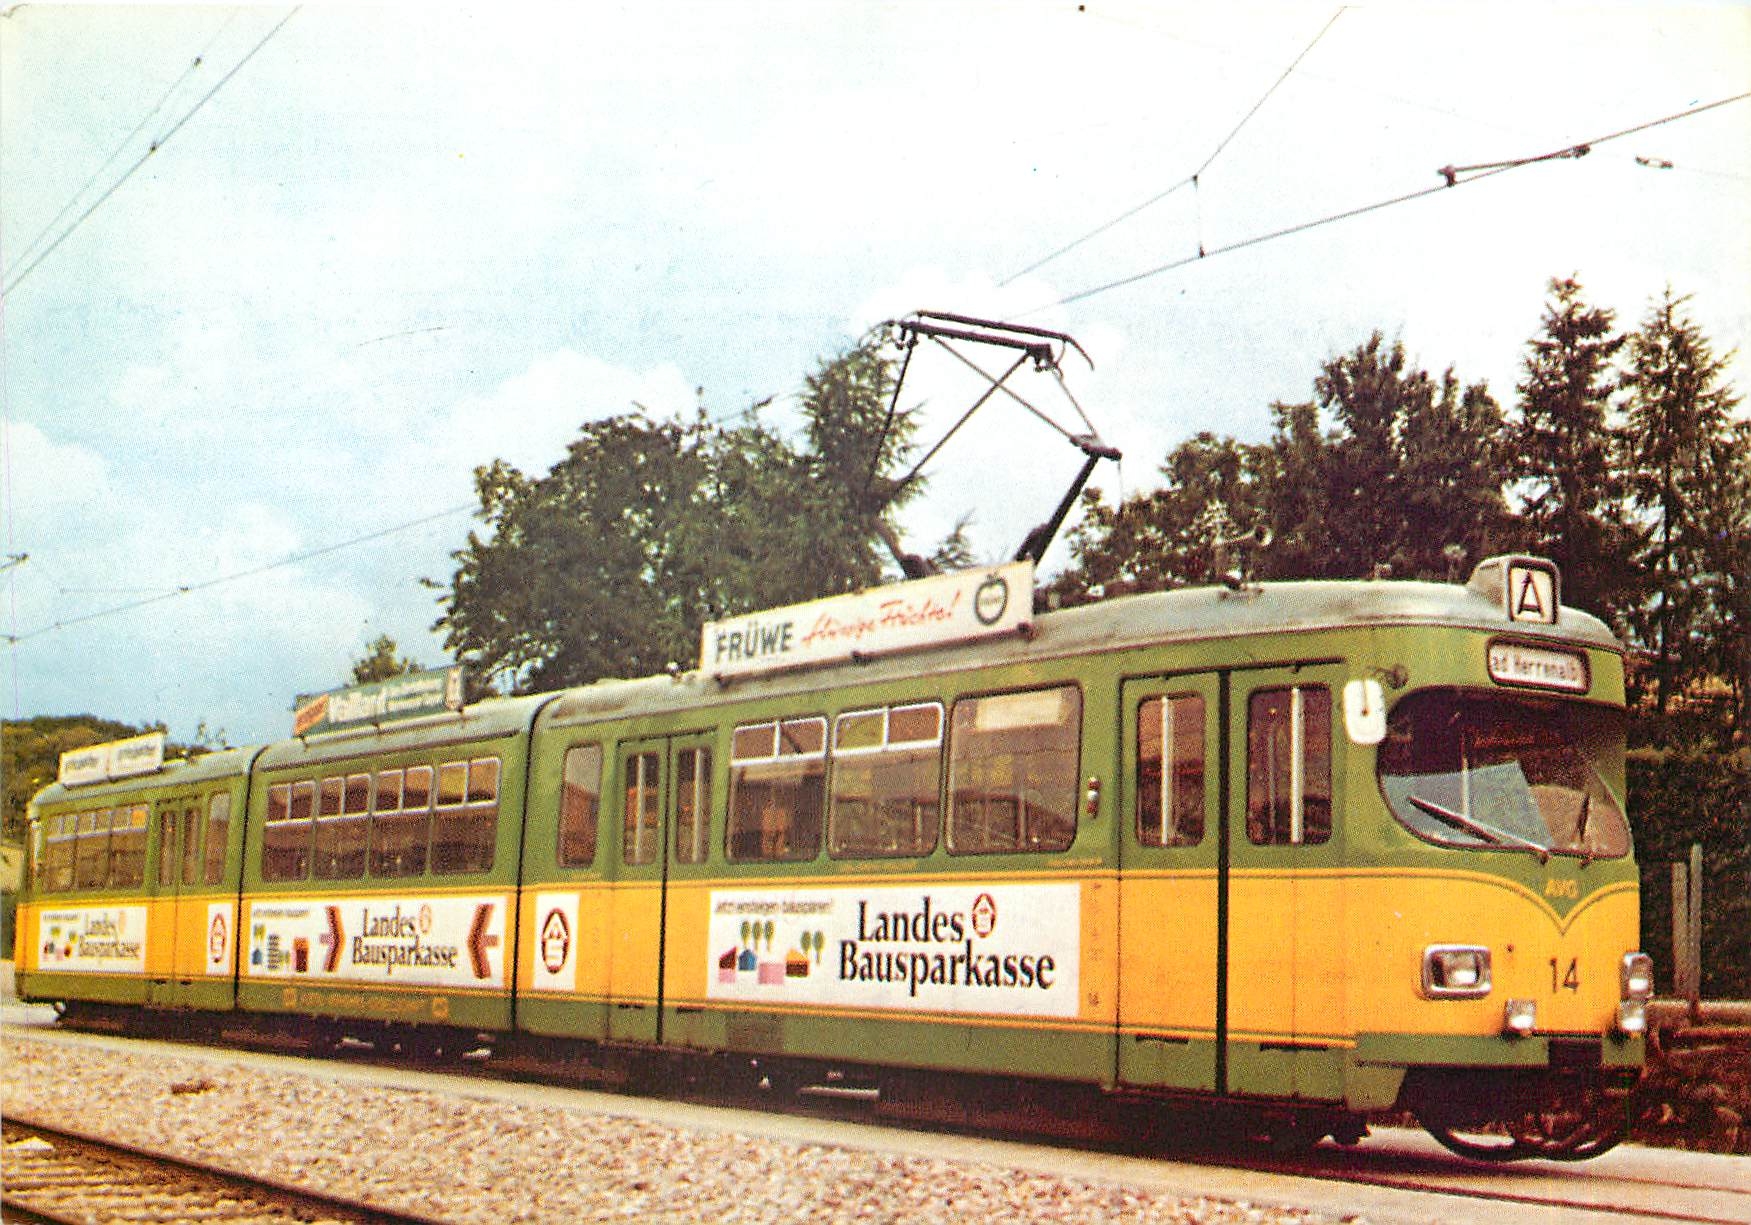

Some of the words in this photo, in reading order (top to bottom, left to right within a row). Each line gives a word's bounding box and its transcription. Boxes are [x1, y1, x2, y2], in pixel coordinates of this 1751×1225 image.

[1518, 570, 1545, 617] A
[714, 619, 794, 663] FRÜWE
[363, 906, 416, 938] Landes
[858, 896, 964, 943] Landes
[352, 935, 458, 976] Bausparkasse
[839, 939, 1056, 997] Bausparkasse
[1550, 957, 1580, 994] 14
